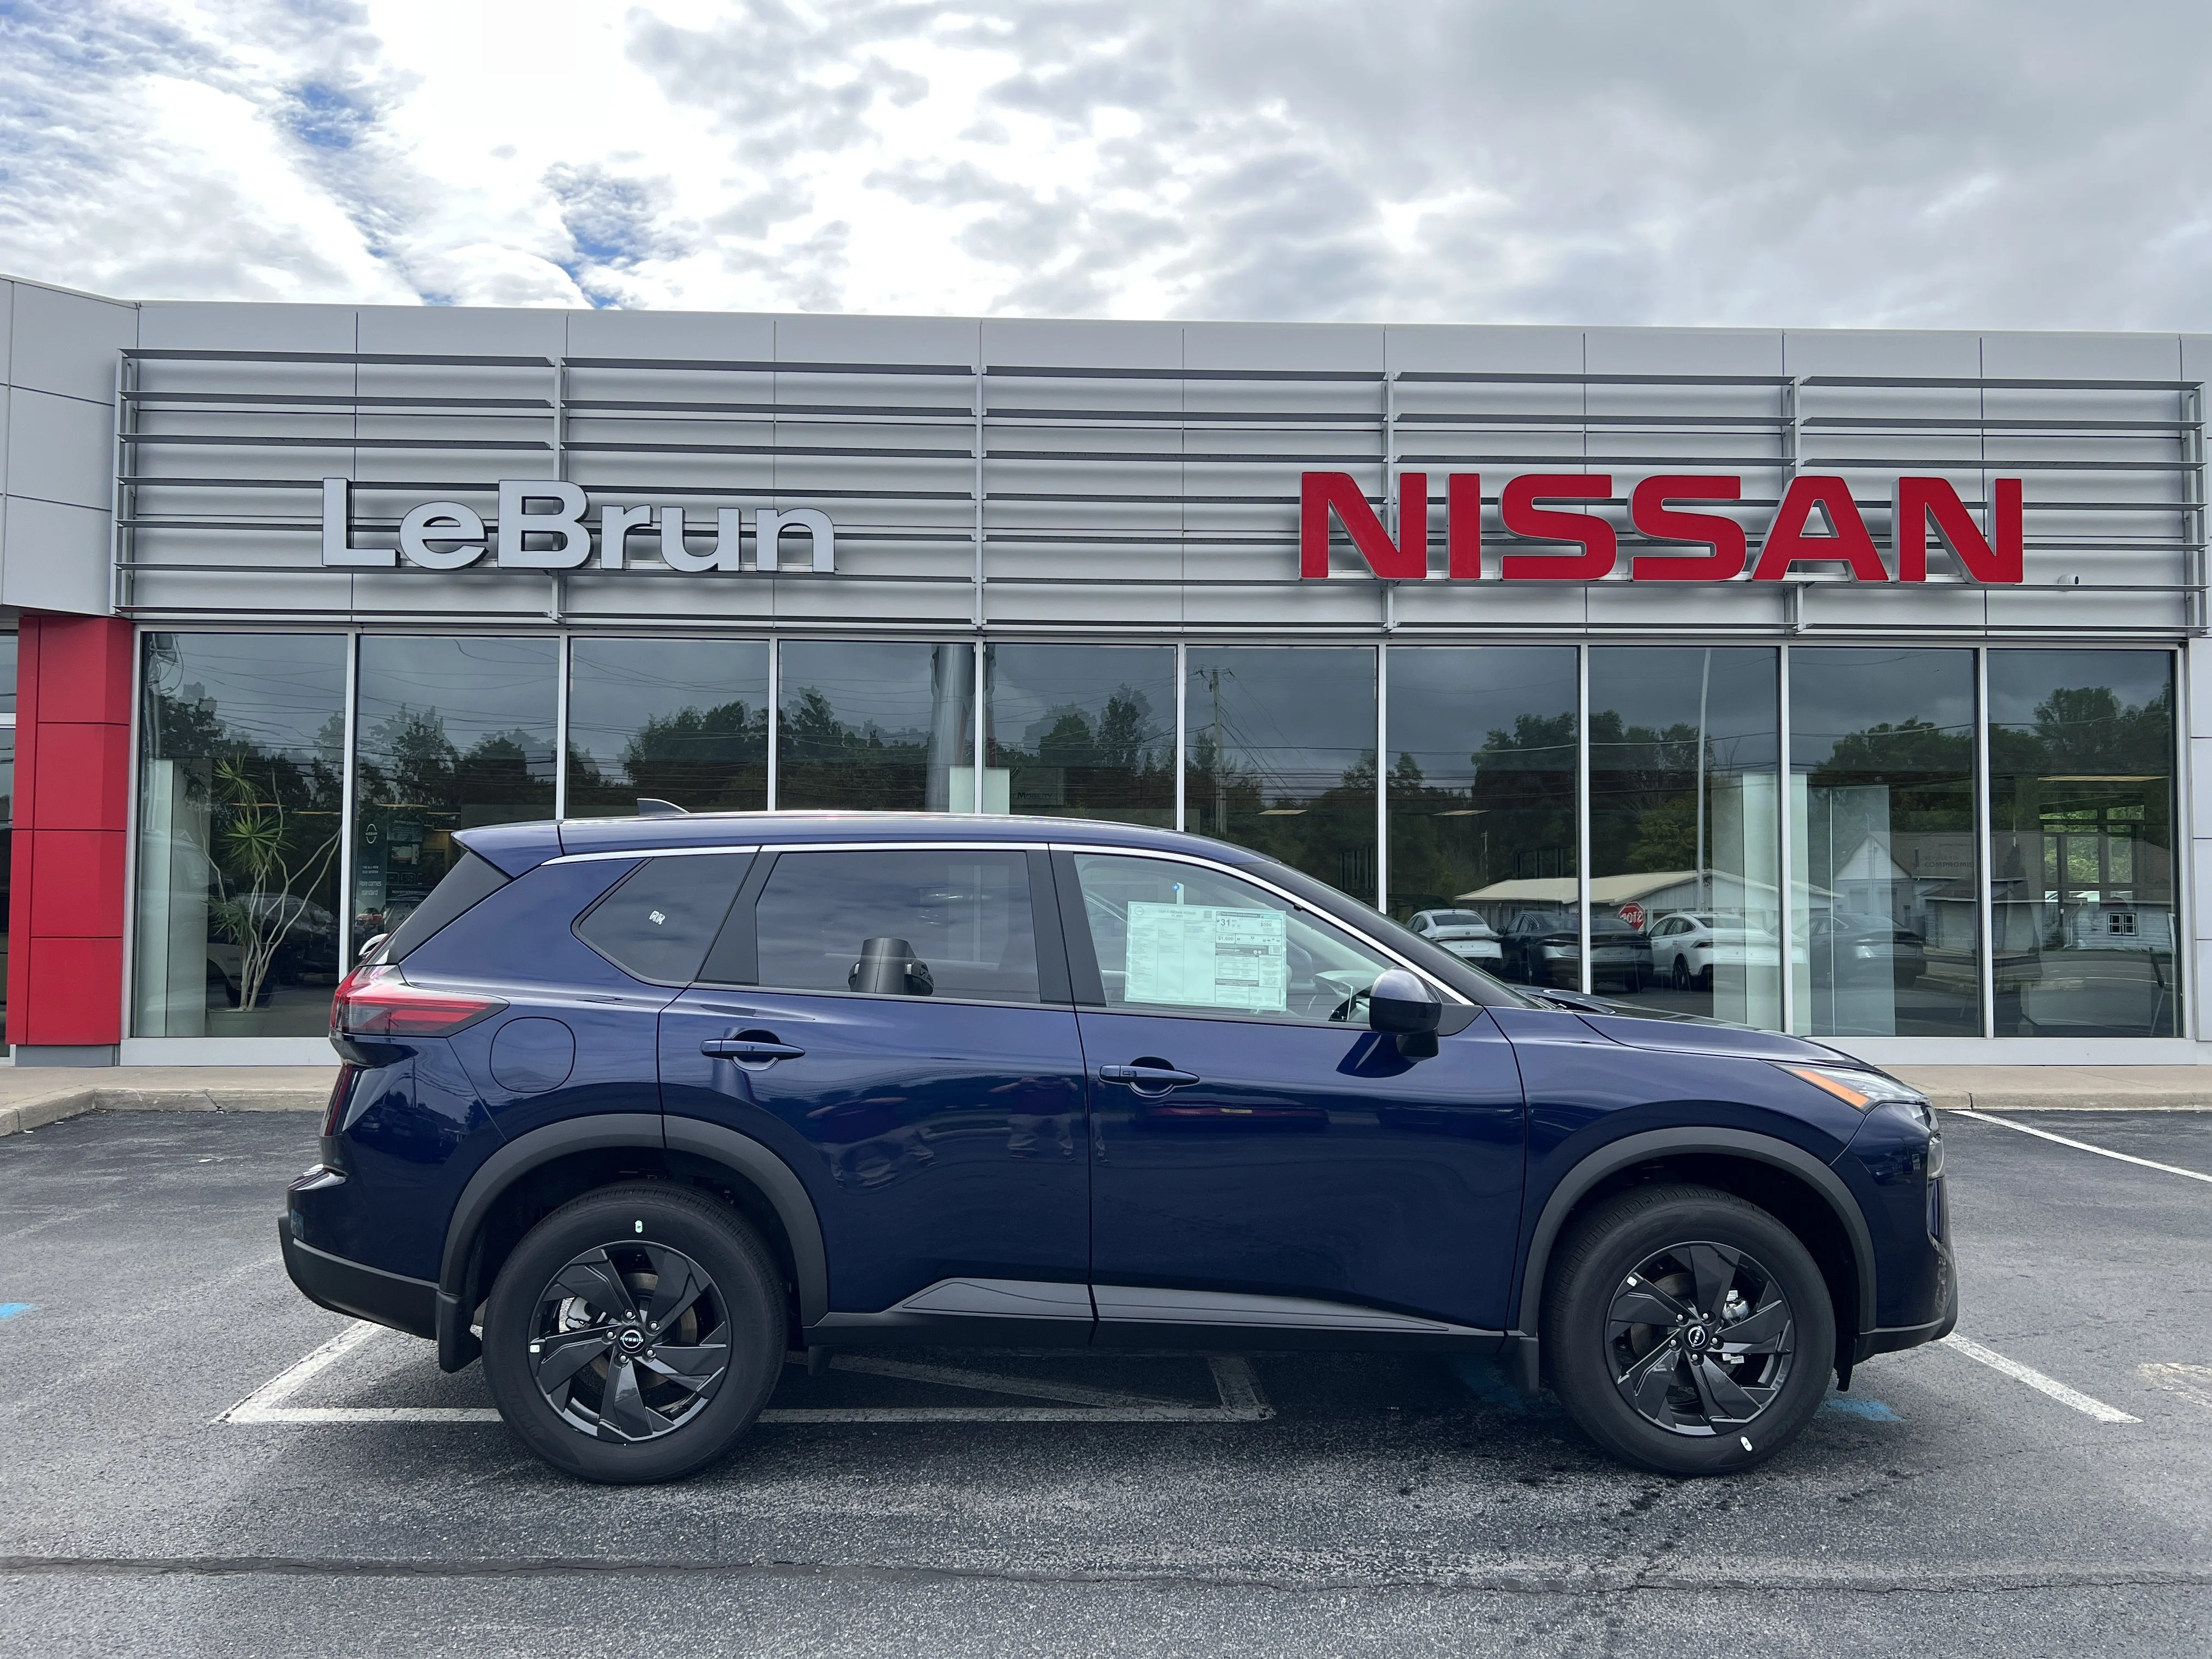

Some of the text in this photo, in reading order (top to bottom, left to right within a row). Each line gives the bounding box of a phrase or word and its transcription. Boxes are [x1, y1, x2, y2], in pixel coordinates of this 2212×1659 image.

[321, 477, 836, 573] LeBrun
[1299, 471, 2023, 583] NISSAN
[649, 910, 665, 925] RR
[1221, 918, 1230, 927] 31
